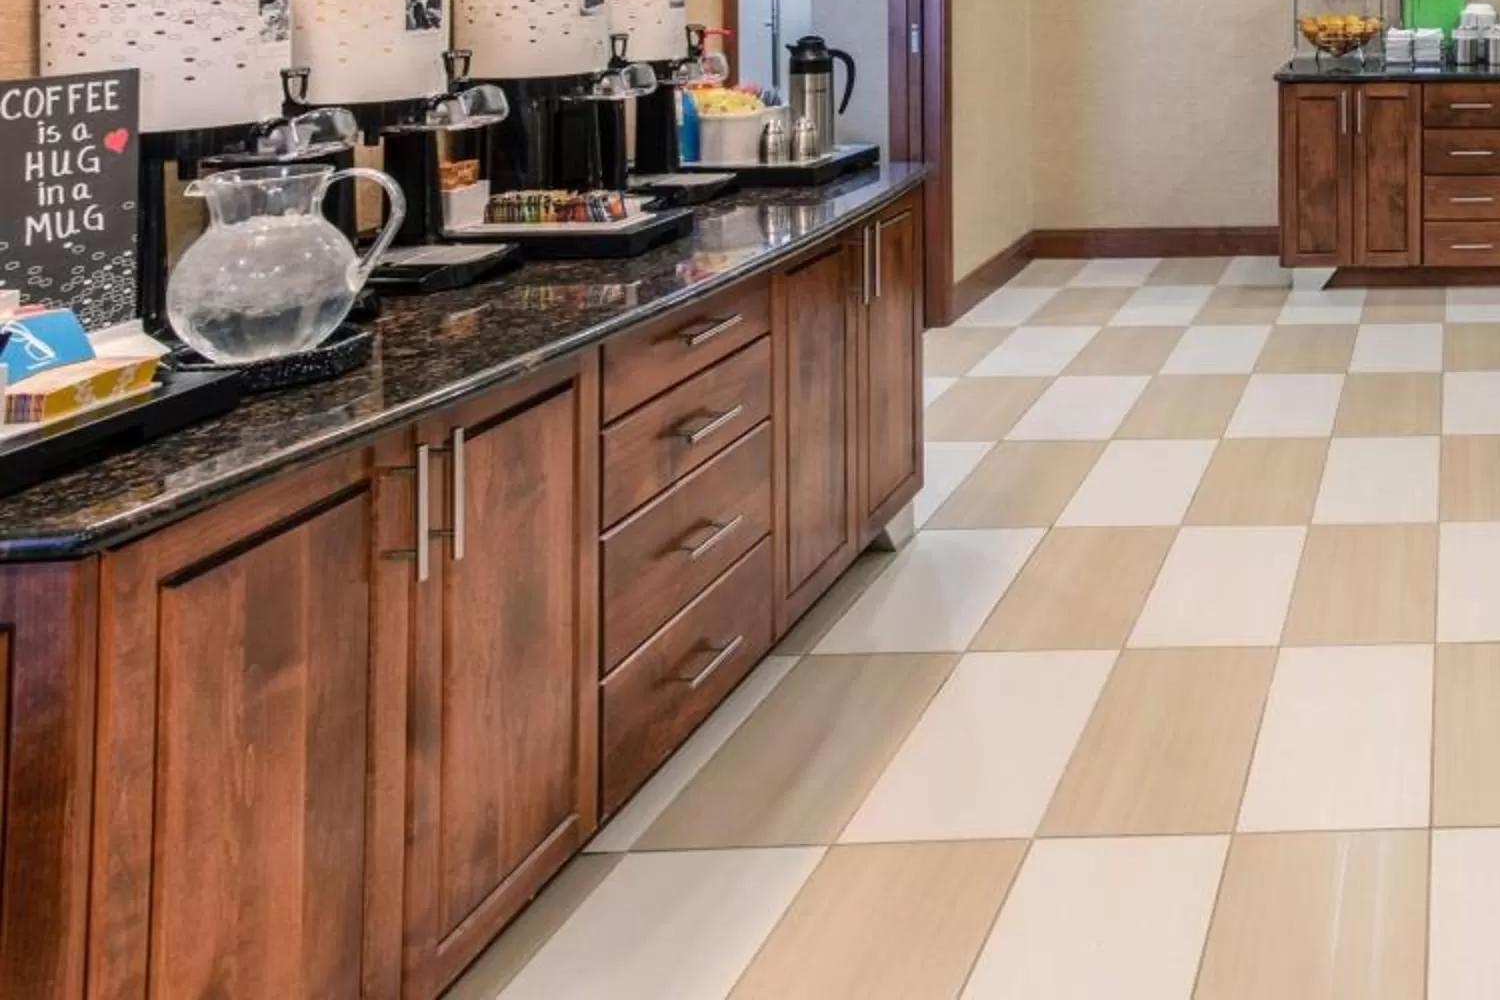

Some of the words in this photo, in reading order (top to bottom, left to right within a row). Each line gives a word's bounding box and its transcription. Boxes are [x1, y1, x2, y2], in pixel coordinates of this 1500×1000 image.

[1, 79, 120, 120] COFFEE
[37, 121, 61, 144] is
[72, 122, 92, 142] a
[25, 145, 101, 182] HUG
[37, 181, 65, 206] in
[71, 182, 92, 201] a
[25, 204, 104, 246] MUG
